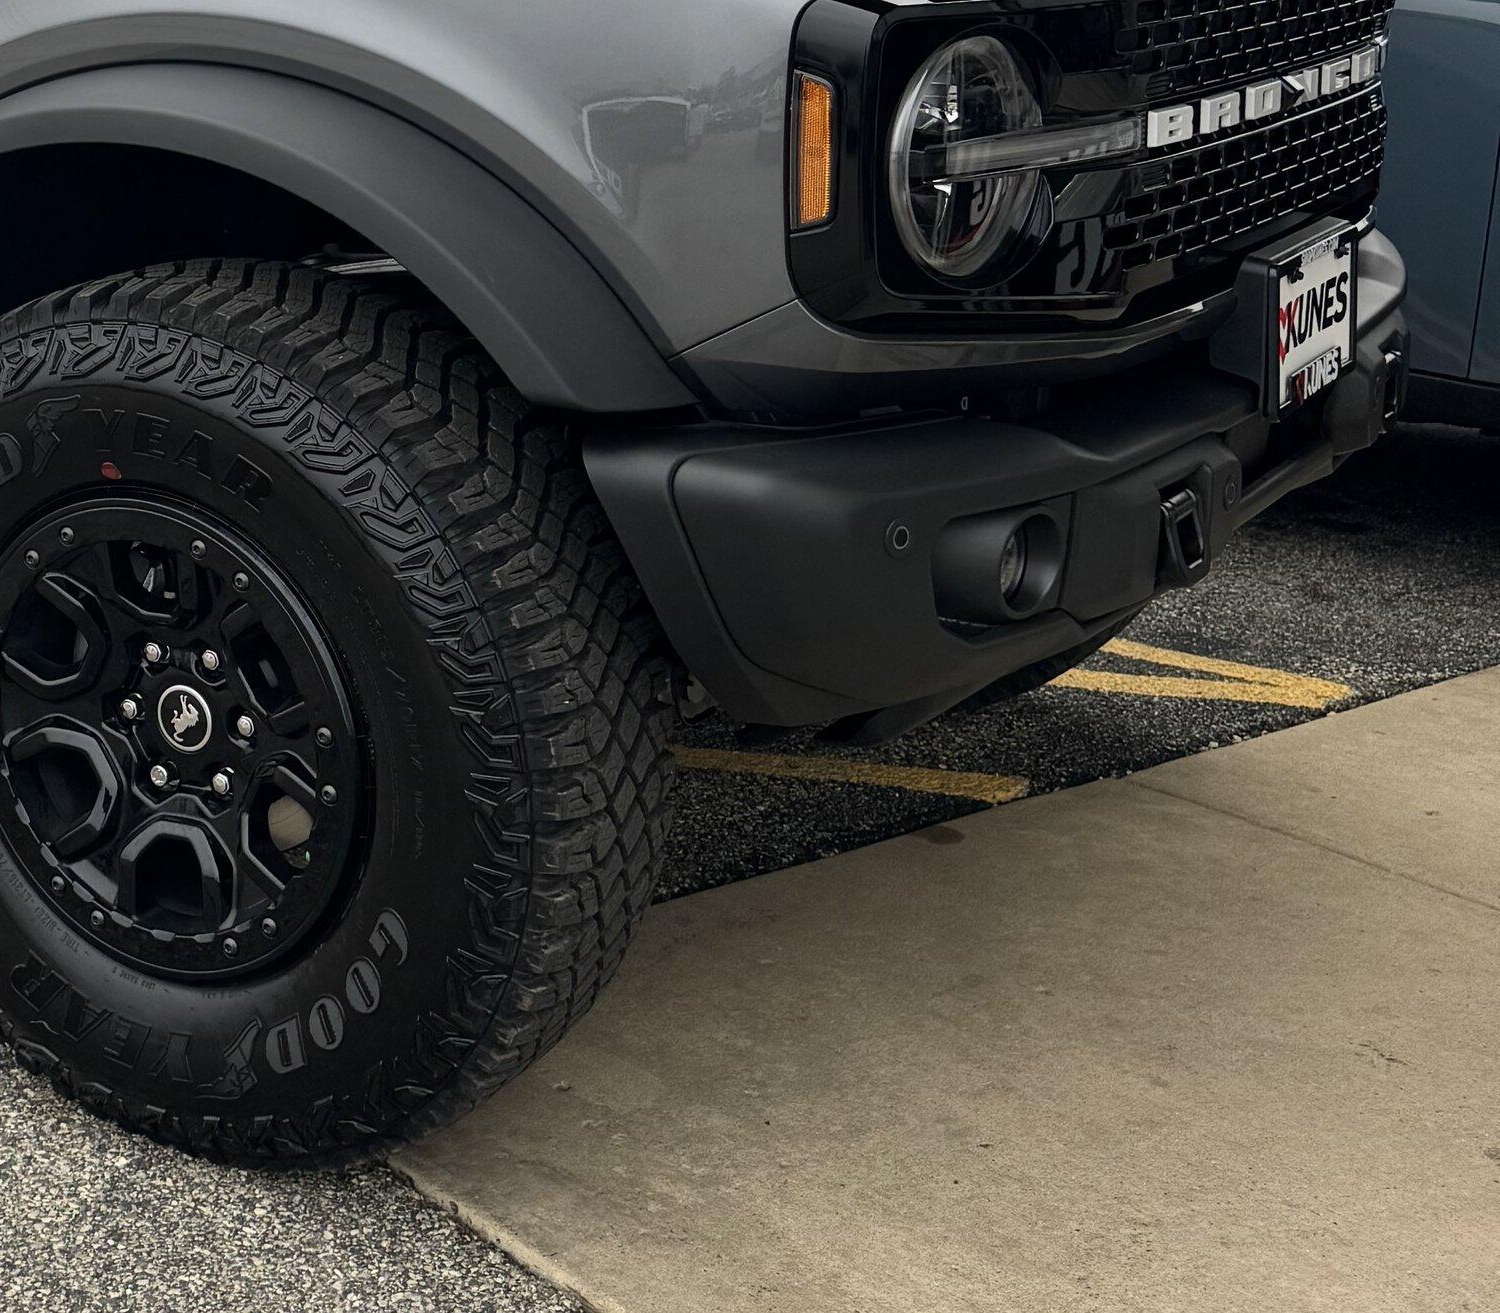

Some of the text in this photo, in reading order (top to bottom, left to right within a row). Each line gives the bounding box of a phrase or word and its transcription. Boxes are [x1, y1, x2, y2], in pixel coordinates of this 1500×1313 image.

[1147, 47, 1379, 148] BRONCO
[1284, 271, 1349, 354] KUNES
[1303, 347, 1339, 400] KUNES
[78, 405, 276, 514] YEAR
[266, 905, 411, 1073] GOOD
